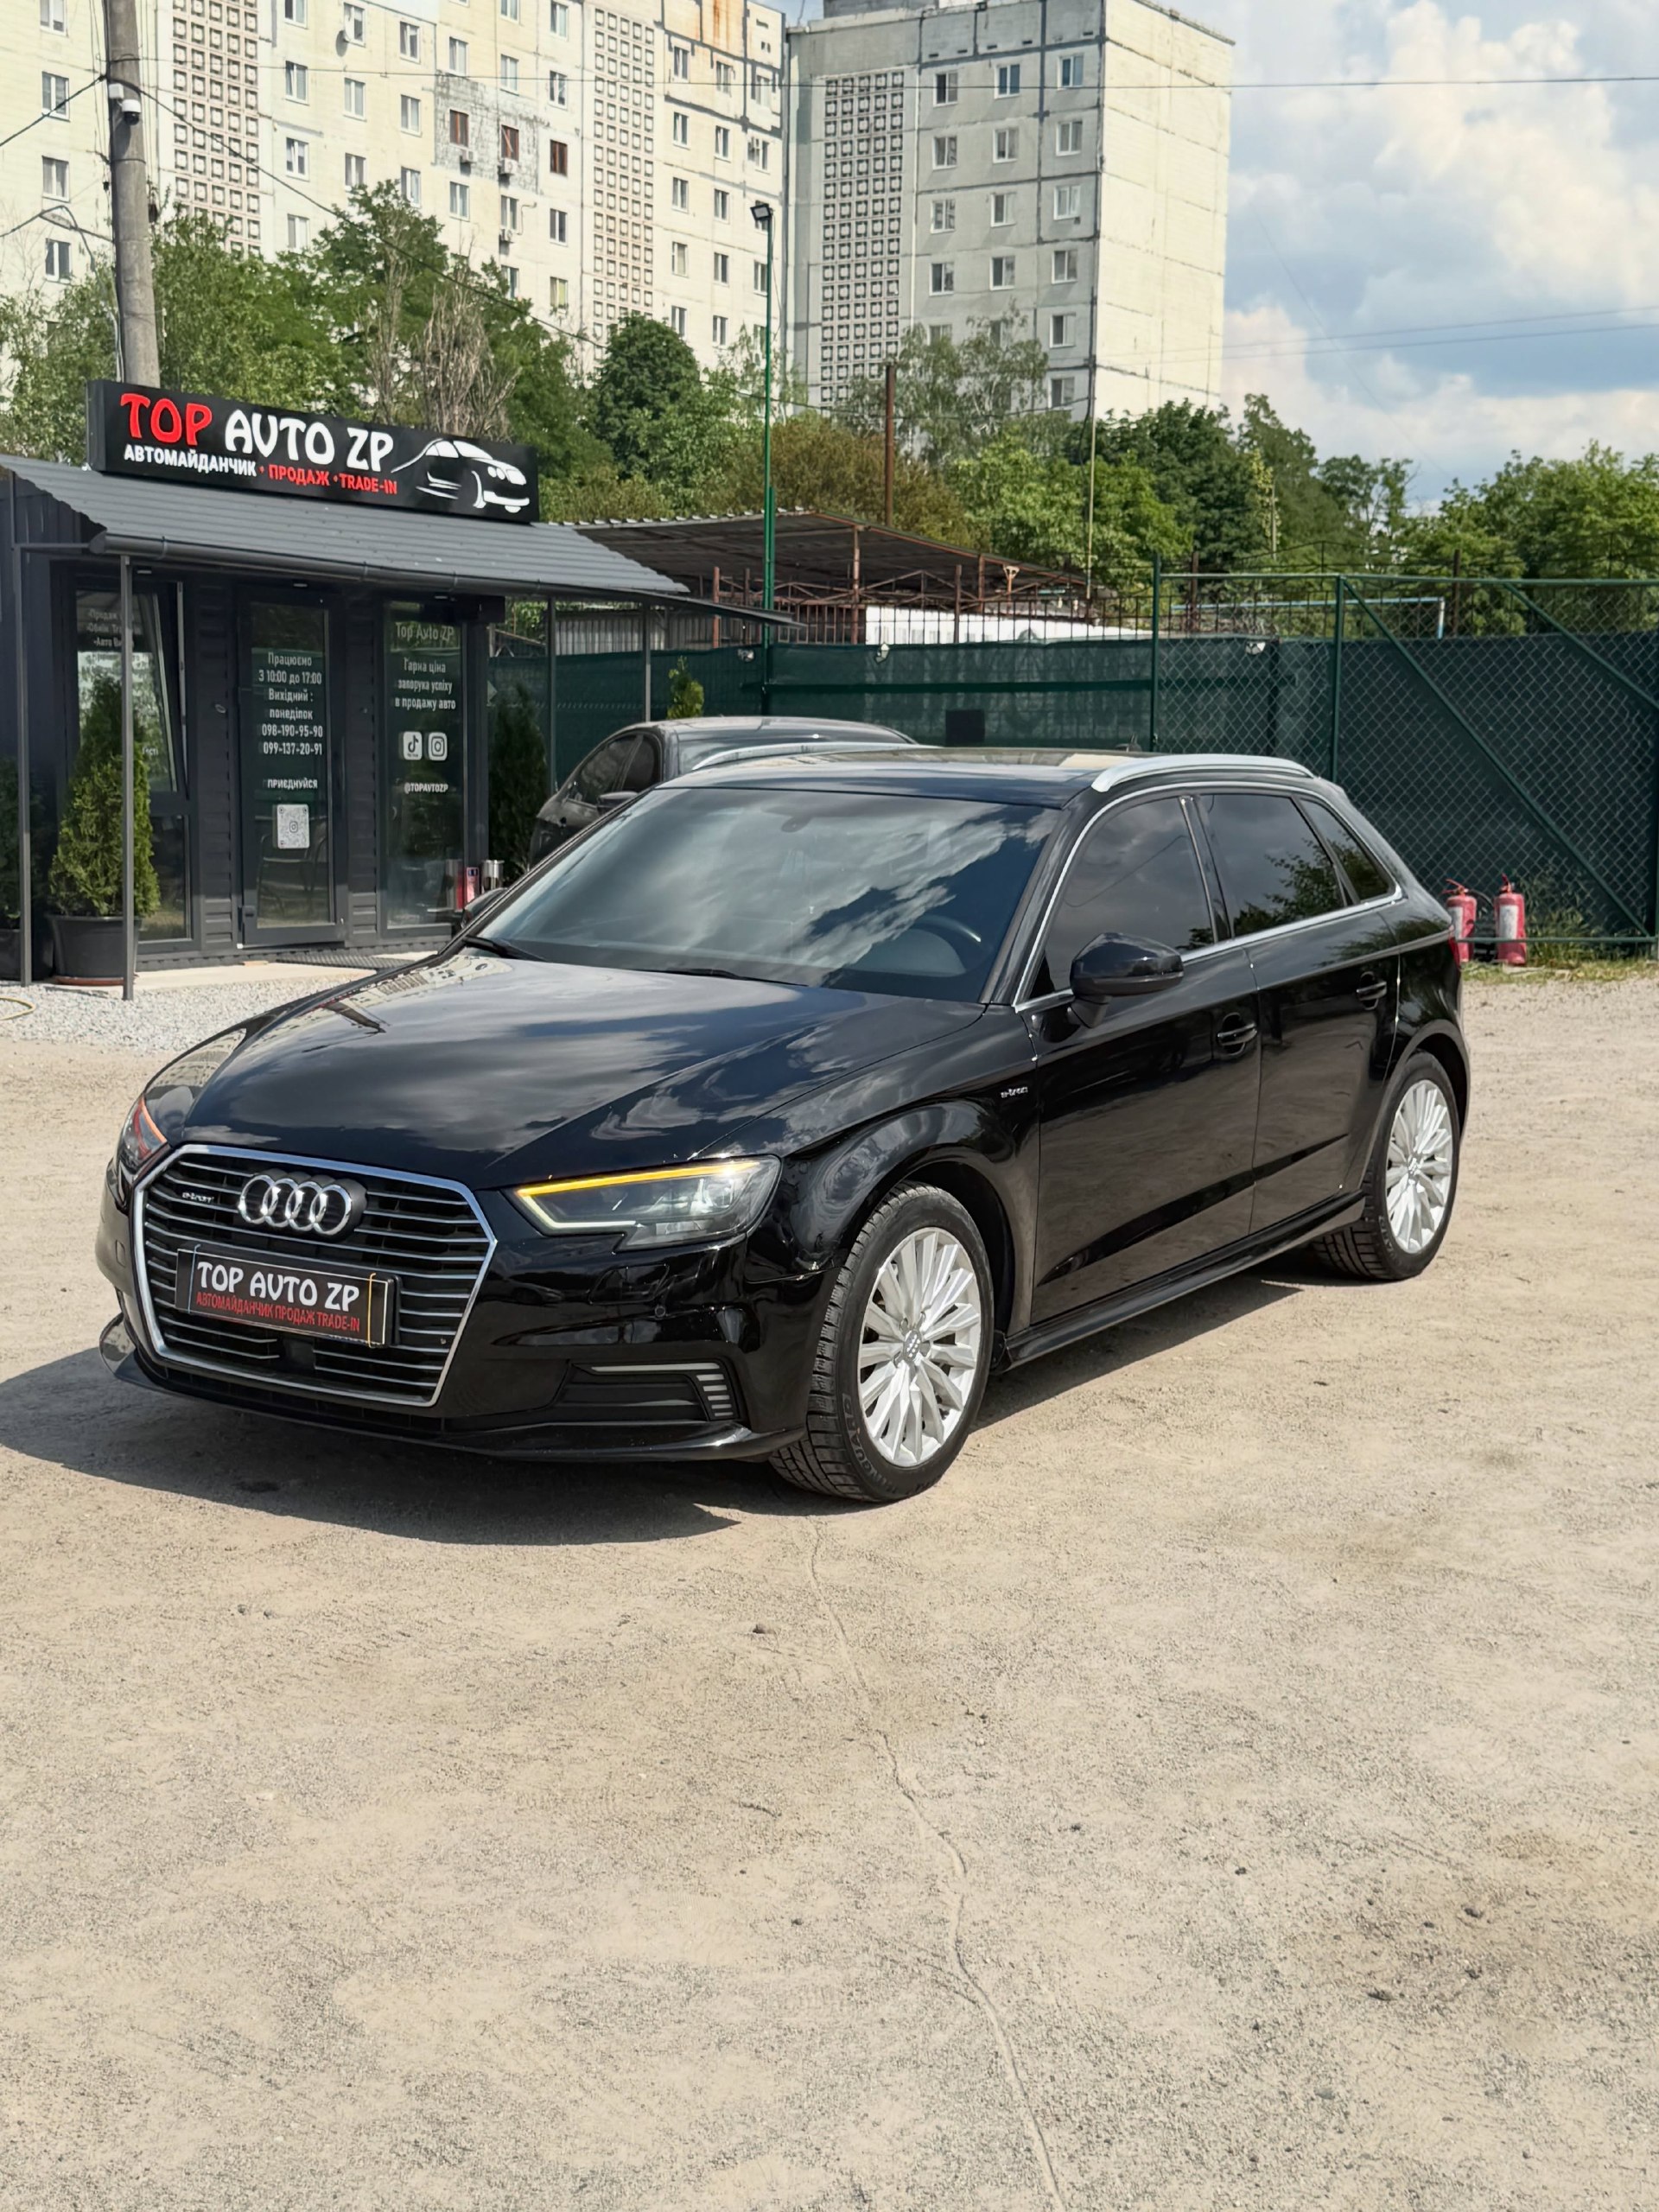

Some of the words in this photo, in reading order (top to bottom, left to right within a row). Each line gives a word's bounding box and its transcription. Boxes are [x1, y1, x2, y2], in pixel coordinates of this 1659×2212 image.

[120, 392, 213, 446] TOP
[346, 427, 394, 472] ZP
[124, 443, 257, 478] АВТОМАЙДАНЧИК
[269, 464, 330, 486] ПРОДАЖ
[340, 473, 397, 494] TRADE-IN
[395, 622, 413, 641] Top
[442, 626, 454, 641] ZP
[268, 652, 312, 667] Працюємо
[429, 659, 446, 674] ціна
[266, 670, 287, 683] 10:00
[289, 673, 300, 684] до
[302, 671, 322, 684] 17:00
[431, 679, 453, 695] успіху
[268, 688, 308, 703] Вихідний
[402, 698, 437, 711] продажу
[438, 699, 456, 709] авто
[262, 724, 323, 738] 098-190-95-90
[263, 741, 323, 756] 099-137-20-91
[197, 1262, 244, 1294] TOP
[324, 1282, 359, 1312] ZP
[196, 1292, 274, 1318] АВТОМАЙДАНЧИК
[276, 1305, 315, 1325] ПРОДАЖ
[316, 1312, 360, 1332] TRADE-IN
